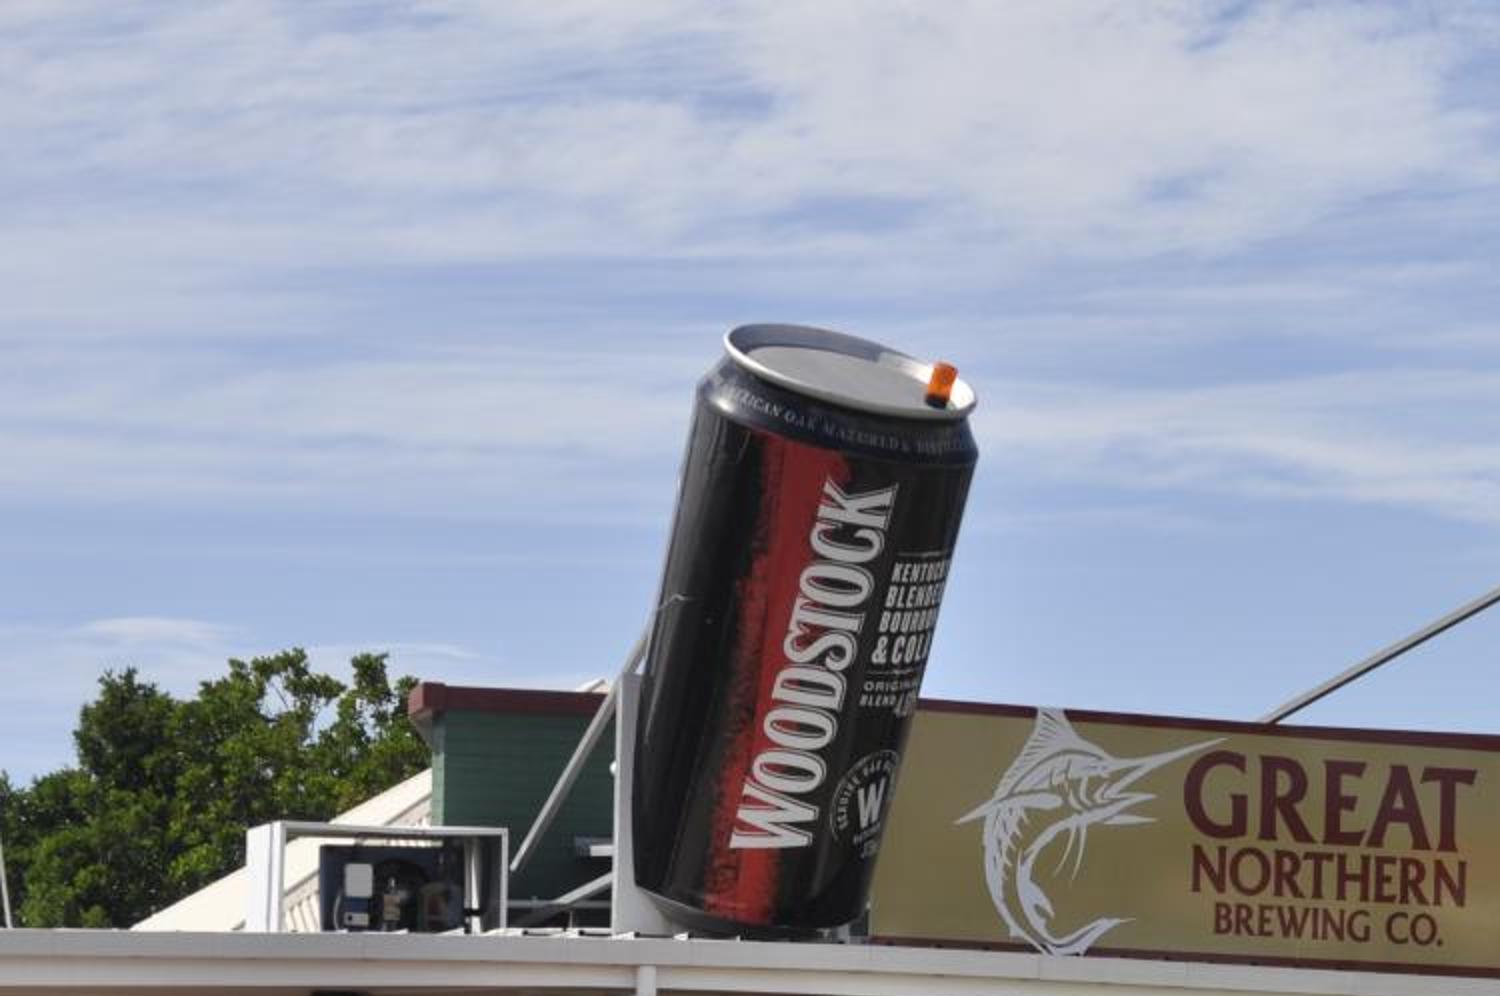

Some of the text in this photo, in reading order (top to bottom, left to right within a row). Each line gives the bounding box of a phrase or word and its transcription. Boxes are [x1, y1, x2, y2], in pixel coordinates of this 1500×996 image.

[728, 479, 898, 852] WOODSTOCK
[1184, 750, 1478, 852] GREAT
[1190, 845, 1468, 907] NORTHERN
[1213, 902, 1444, 947] BREWING CO.
